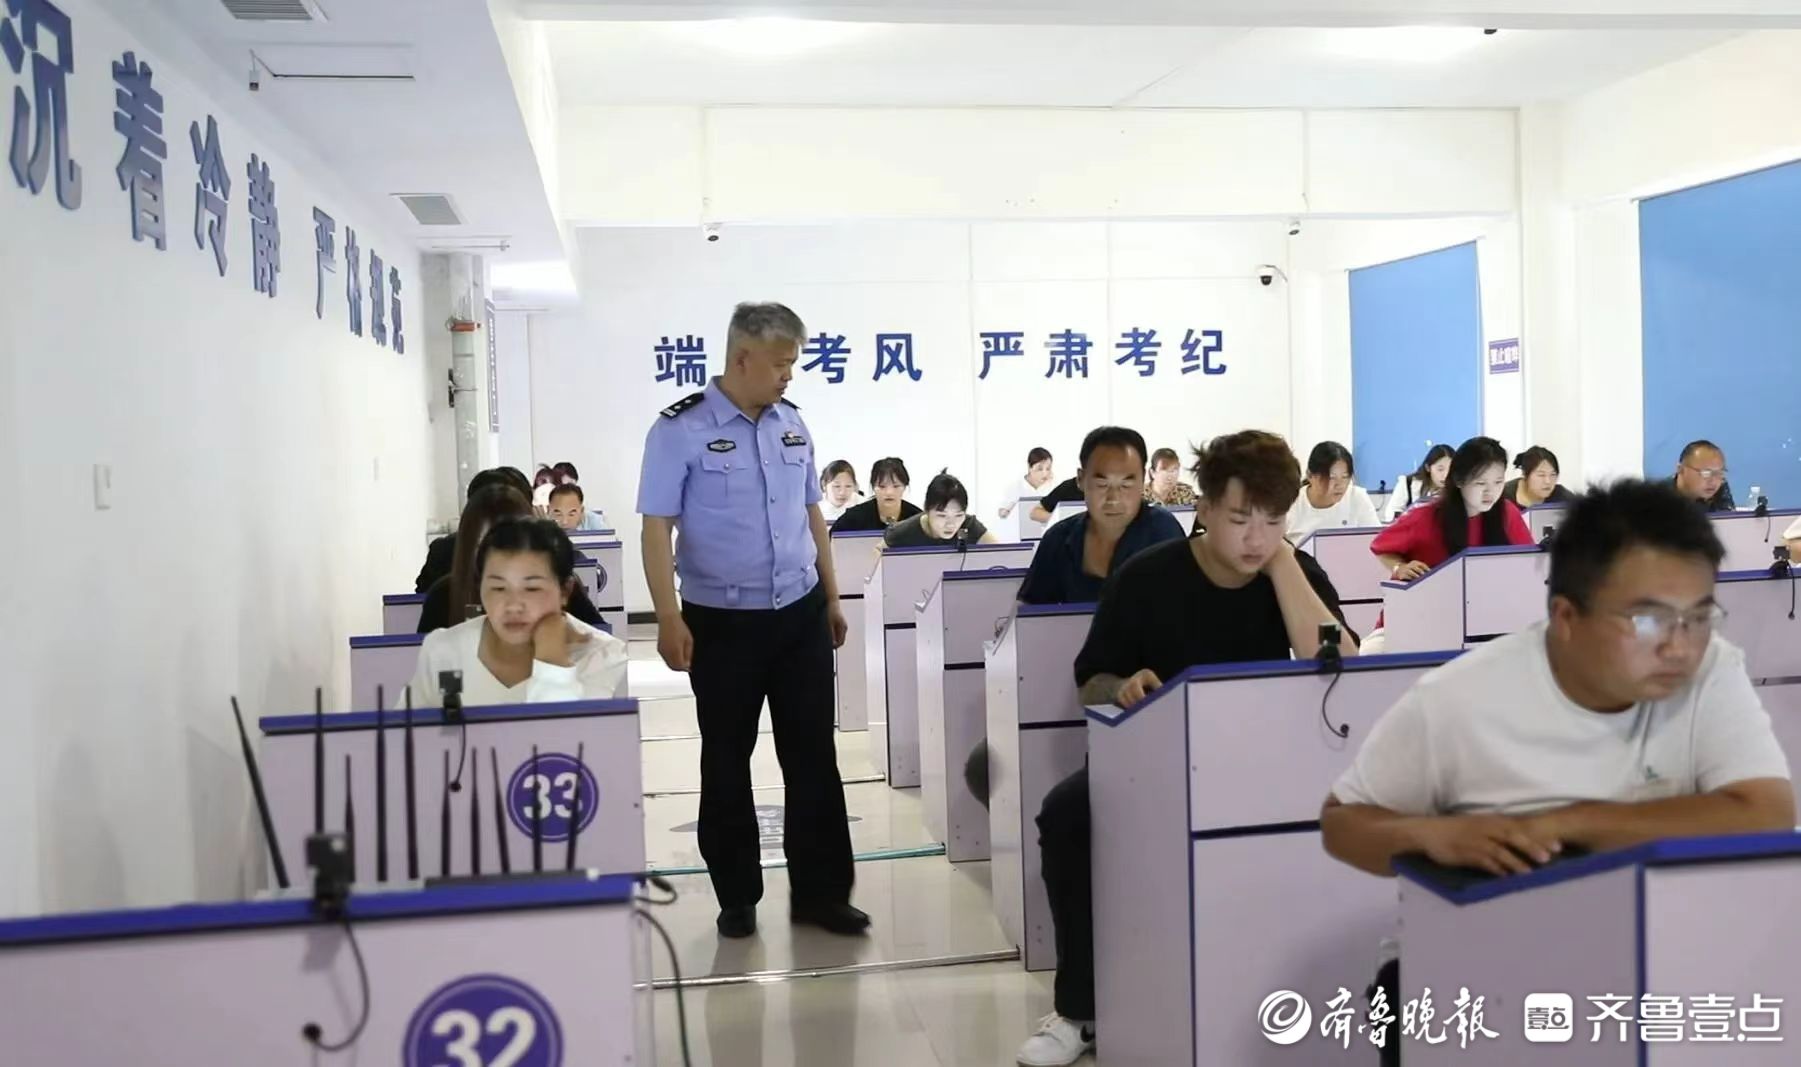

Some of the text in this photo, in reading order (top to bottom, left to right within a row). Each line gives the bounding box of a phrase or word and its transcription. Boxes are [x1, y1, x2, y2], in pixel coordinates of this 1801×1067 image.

[0, 0, 281, 298] 沉着冷静
[654, 328, 1228, 386] 端考风 严肃考纪
[523, 772, 583, 820] 33
[431, 1007, 537, 1067] 32
